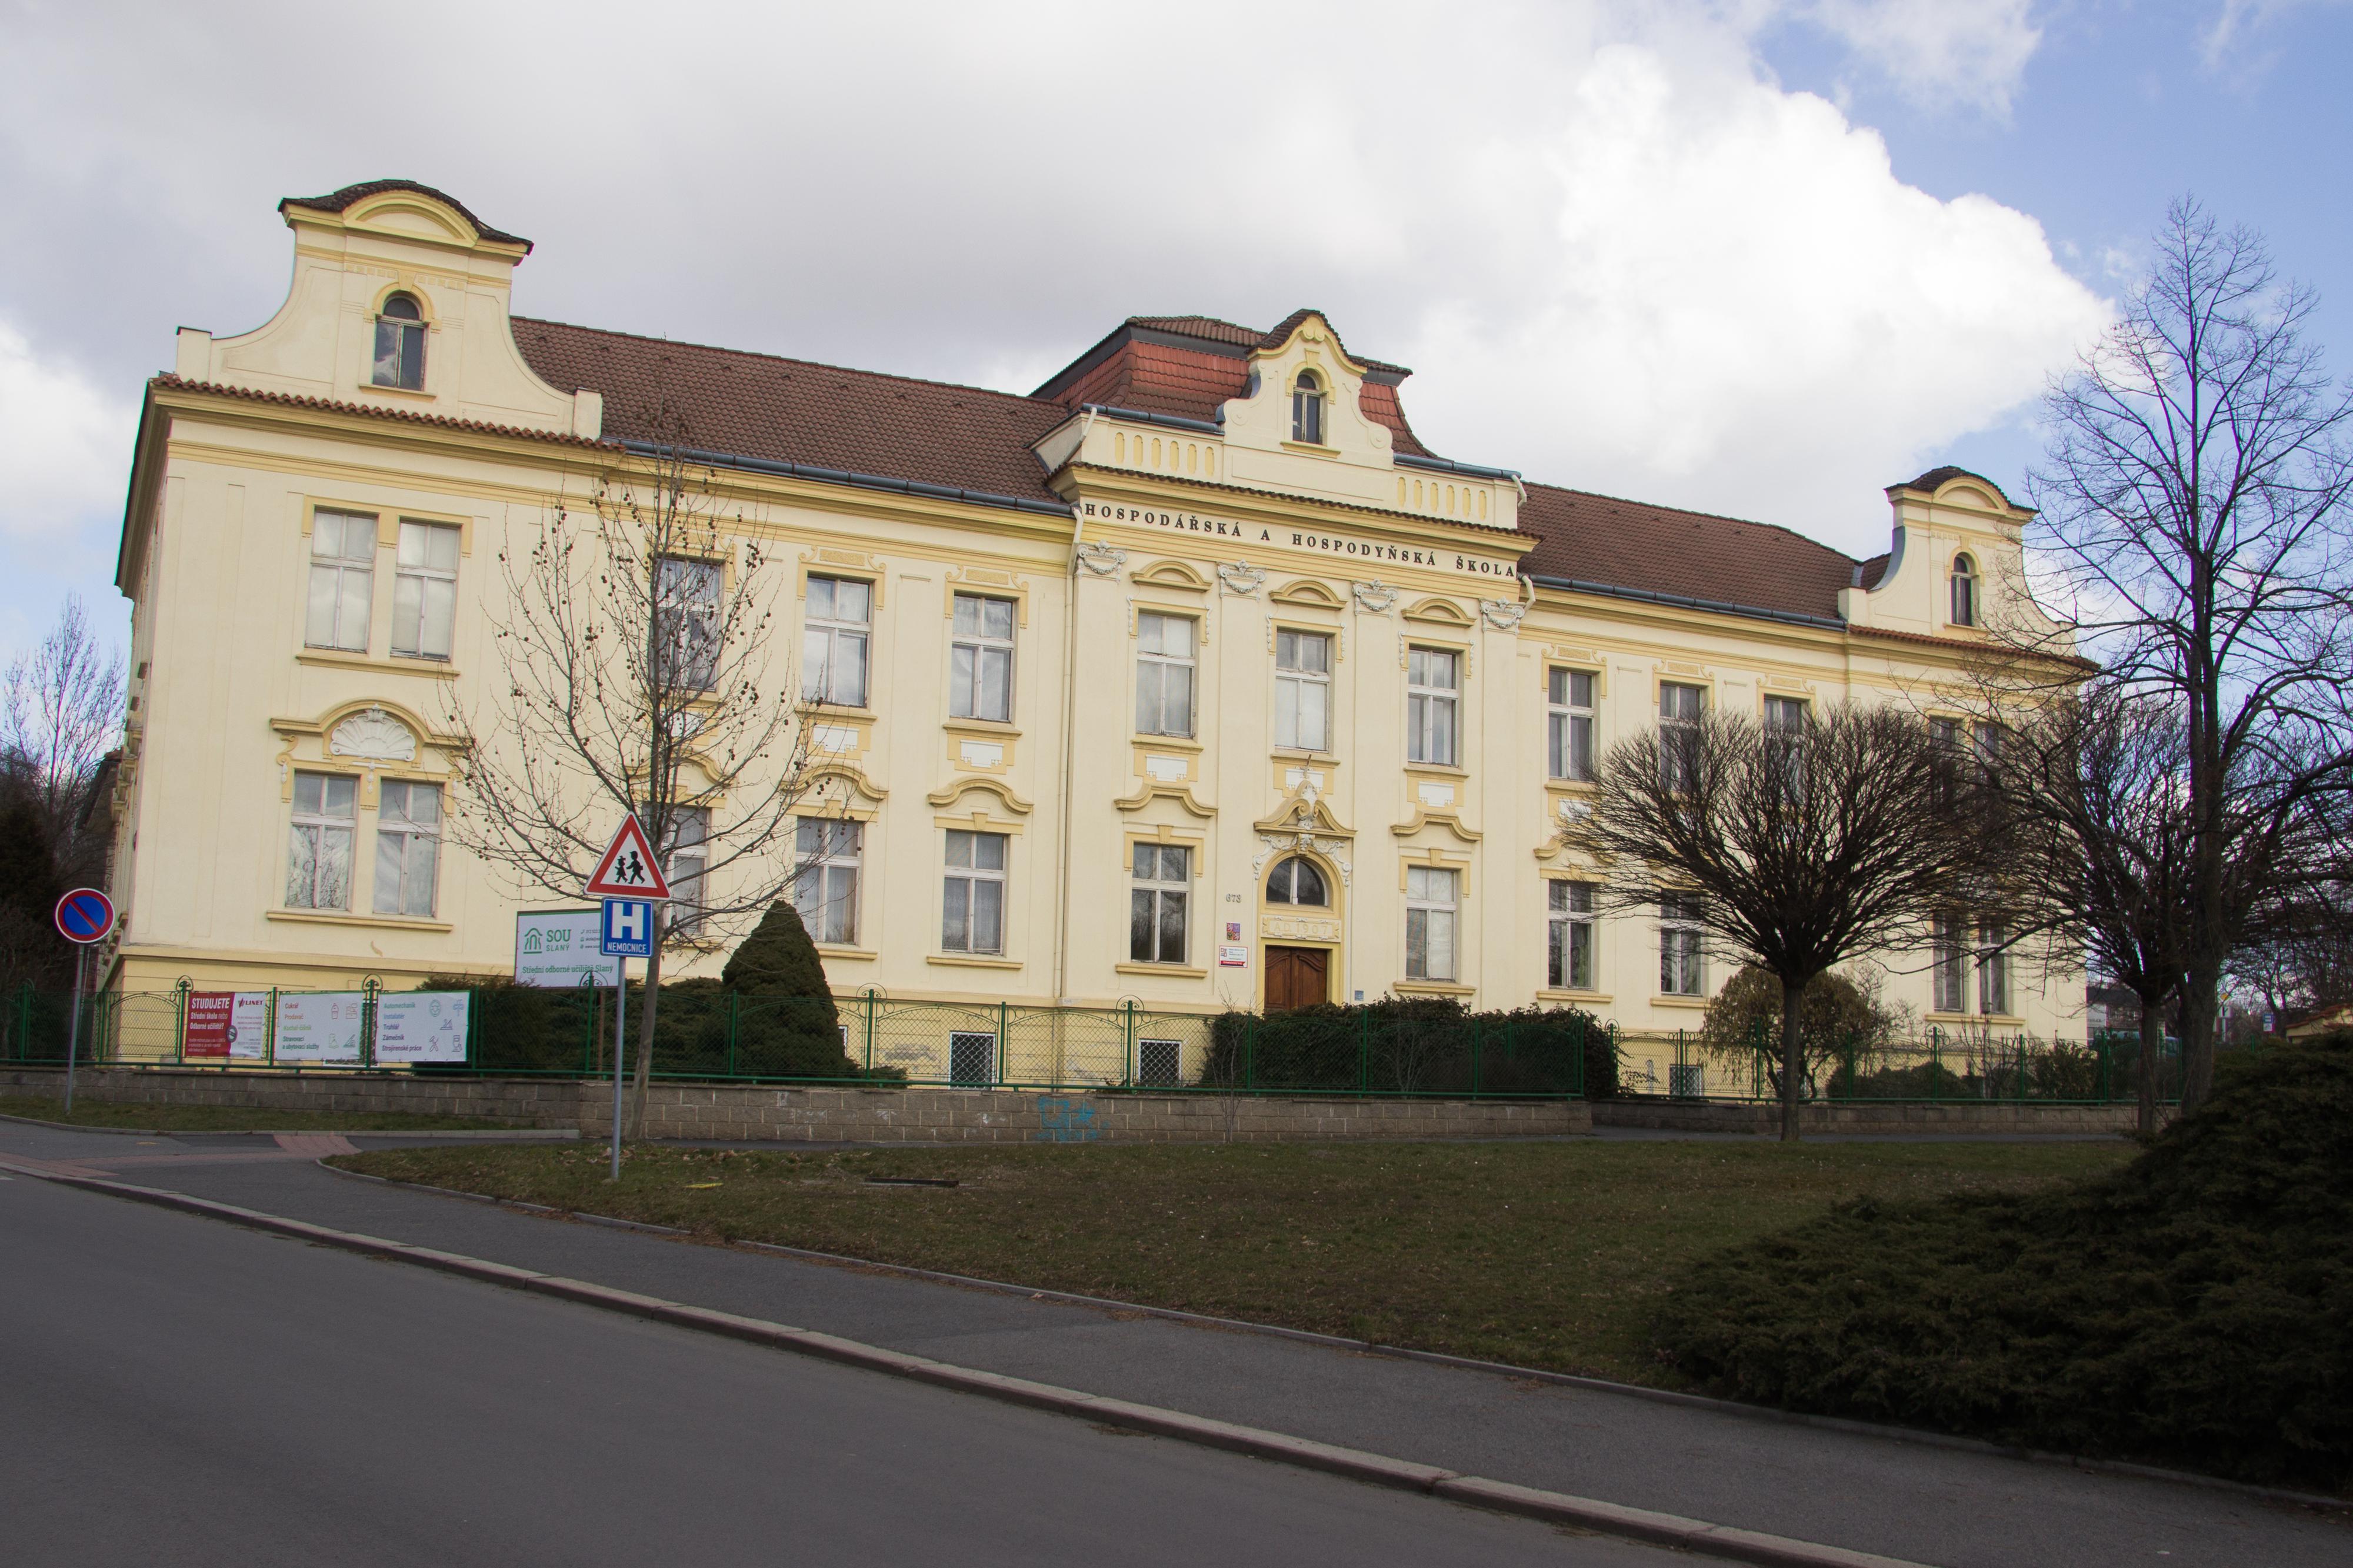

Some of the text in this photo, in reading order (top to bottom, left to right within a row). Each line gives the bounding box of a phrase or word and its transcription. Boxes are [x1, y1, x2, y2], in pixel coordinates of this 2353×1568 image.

[1085, 503, 1515, 577] HOSPODÁŘSKÁ A HOSPODYŇSKÁ ŠKOLA
[611, 902, 644, 940] H
[1296, 923, 1327, 935] 1907
[546, 929, 571, 942] SOU
[546, 943, 570, 952] SLANÝ
[607, 942, 646, 953] NEMOCNICE
[545, 965, 570, 973] odborné
[595, 964, 614, 973] Slaný
[192, 997, 231, 1010] STUDUJETE
